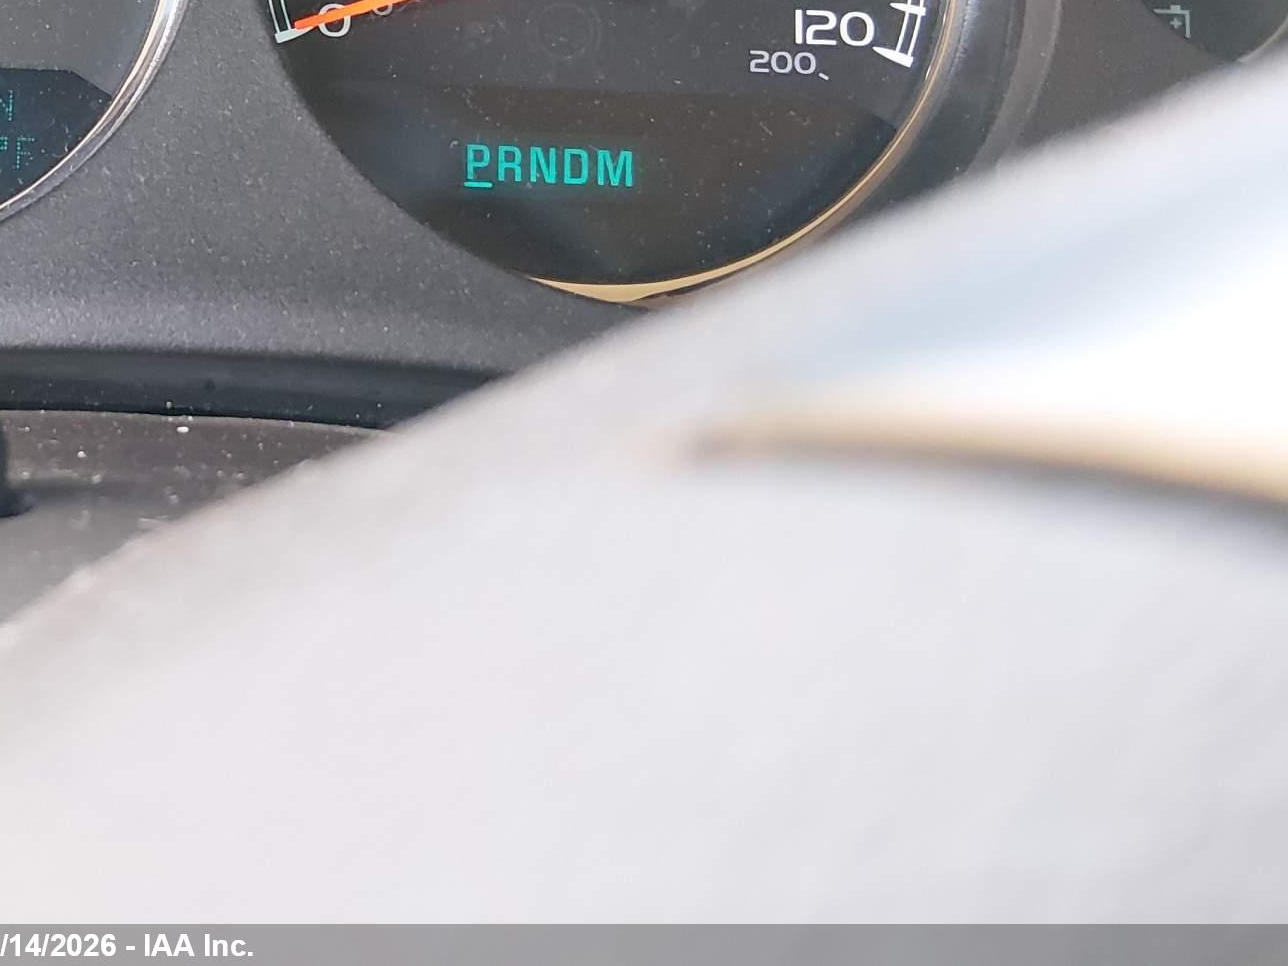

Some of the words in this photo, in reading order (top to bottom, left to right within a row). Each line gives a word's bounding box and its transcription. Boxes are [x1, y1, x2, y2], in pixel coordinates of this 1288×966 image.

[318, 3, 351, 37] 0
[794, 10, 875, 46] 120
[749, 51, 816, 74] 200
